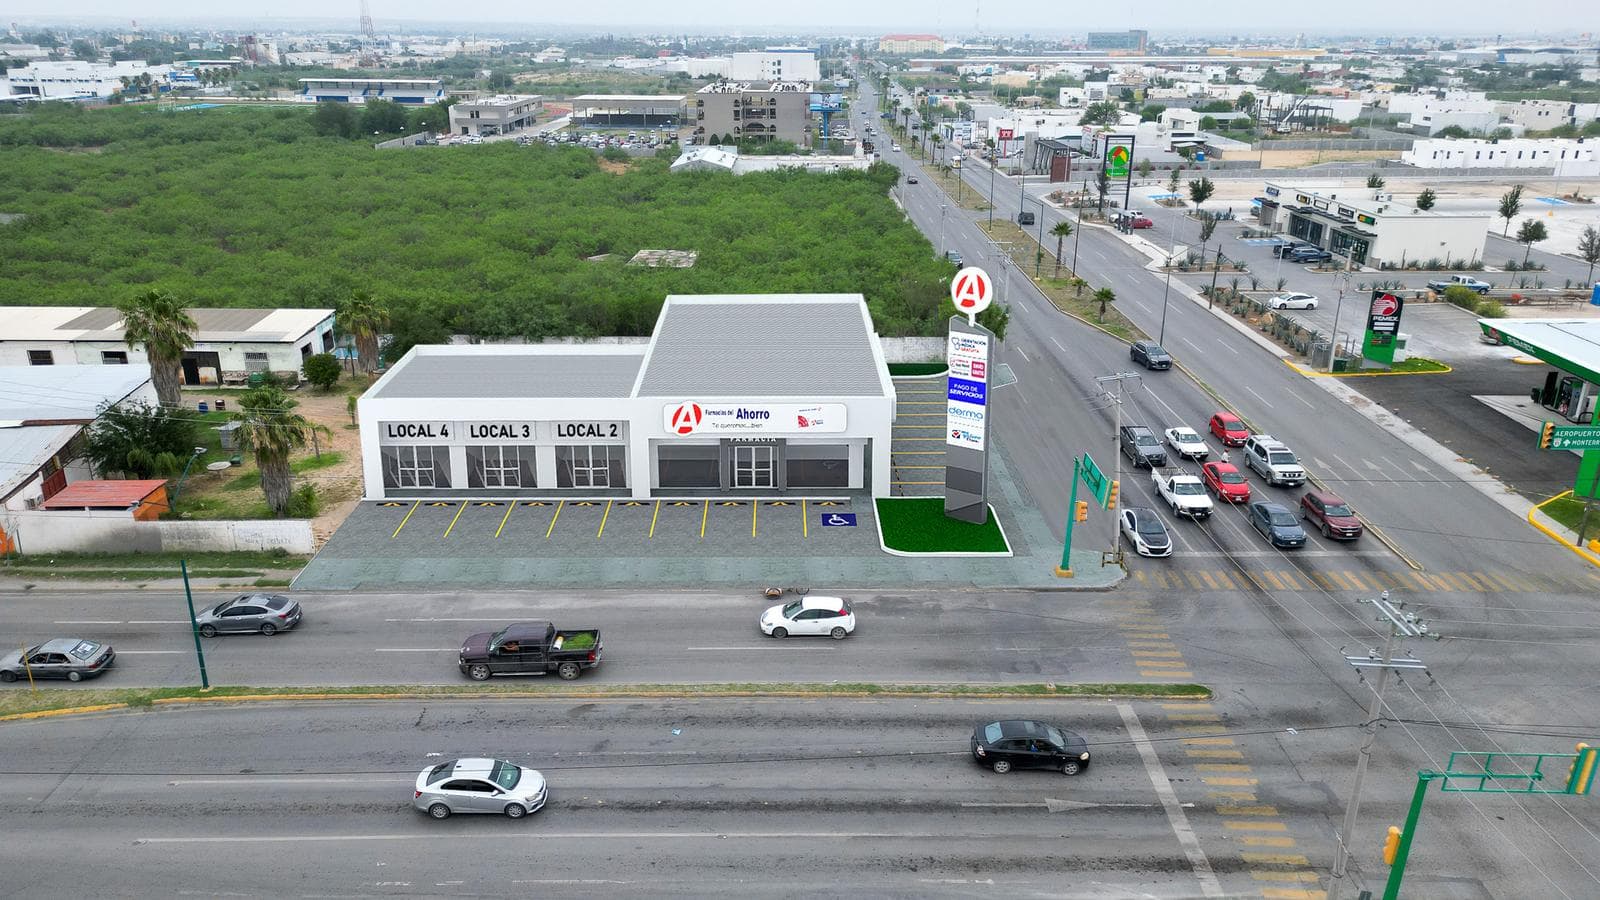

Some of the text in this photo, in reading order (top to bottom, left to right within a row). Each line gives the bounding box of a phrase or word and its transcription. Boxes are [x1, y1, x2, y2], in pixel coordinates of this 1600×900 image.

[953, 383, 969, 391] PAGO
[949, 388, 984, 399] SERVICIOS
[736, 407, 770, 419] Ahorro
[948, 407, 984, 419] derma
[388, 424, 449, 438] LOCAL 4
[470, 424, 530, 438] LOCAL 3
[557, 423, 618, 437] LOCAL 2
